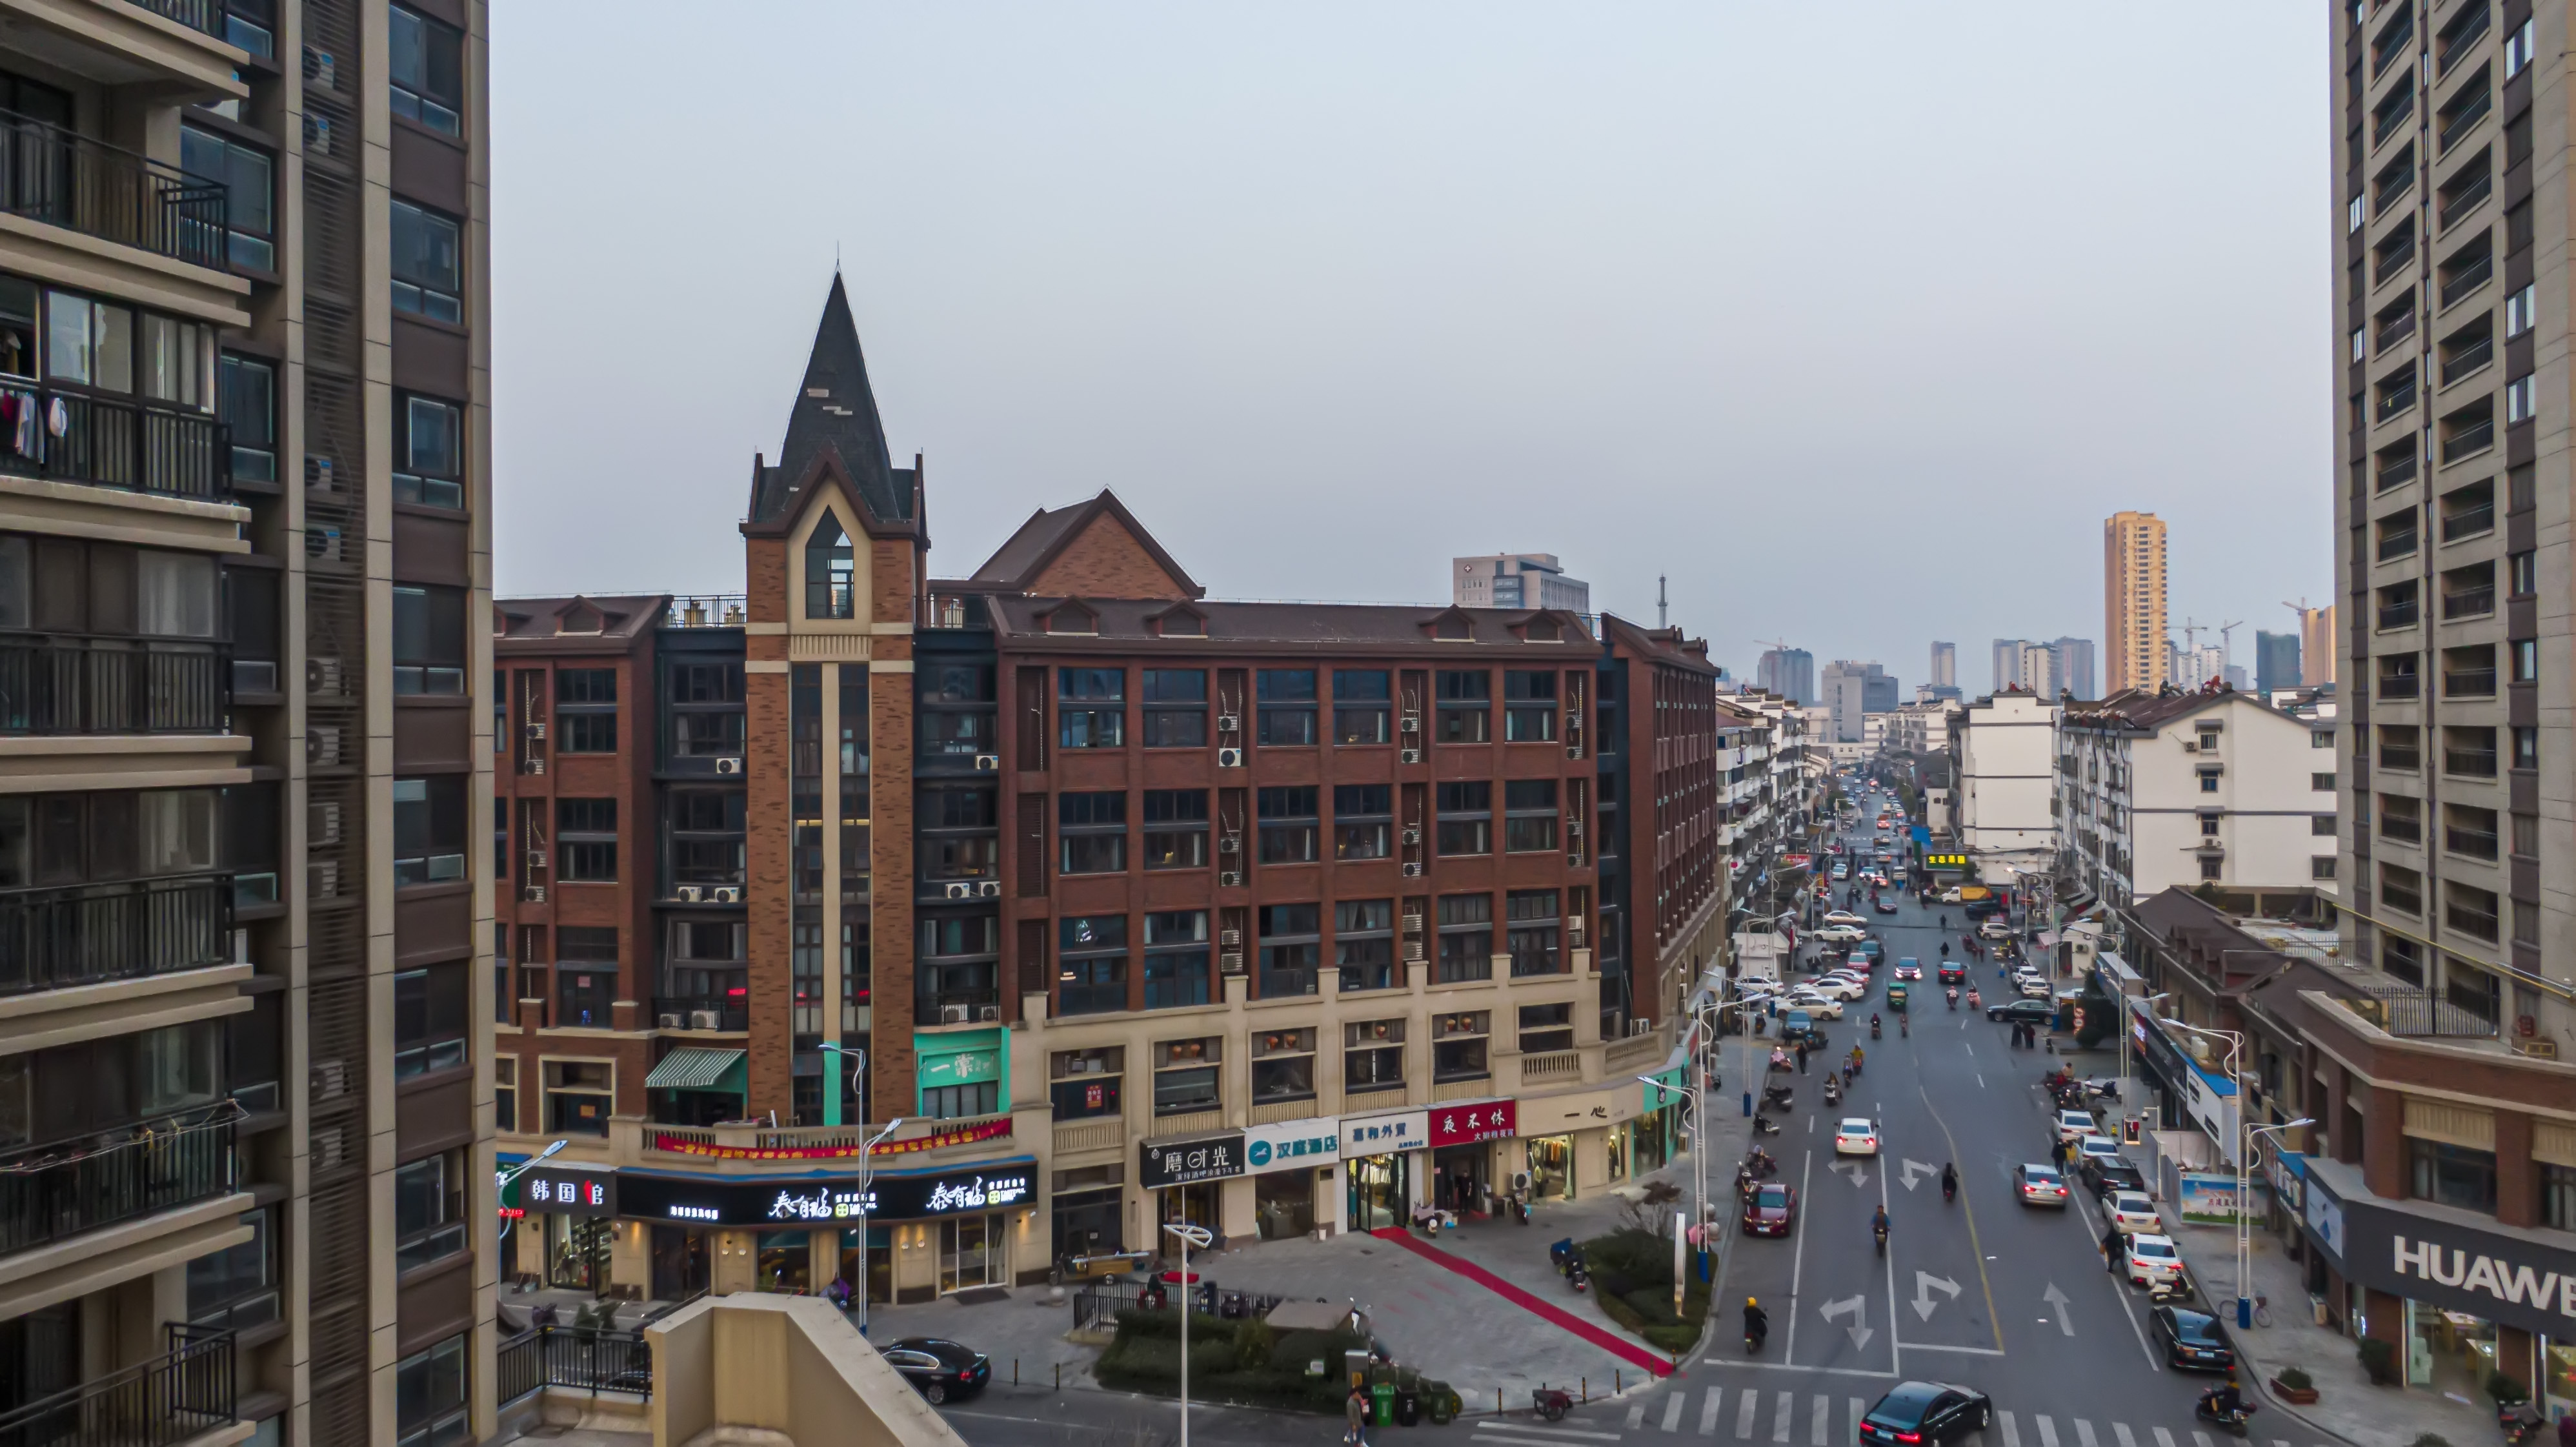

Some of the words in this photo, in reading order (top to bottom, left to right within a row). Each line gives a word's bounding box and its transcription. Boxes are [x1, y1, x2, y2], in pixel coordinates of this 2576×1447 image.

[1444, 1108, 1505, 1133] 夜不休
[1276, 1135, 1338, 1159] 汉庭酒店
